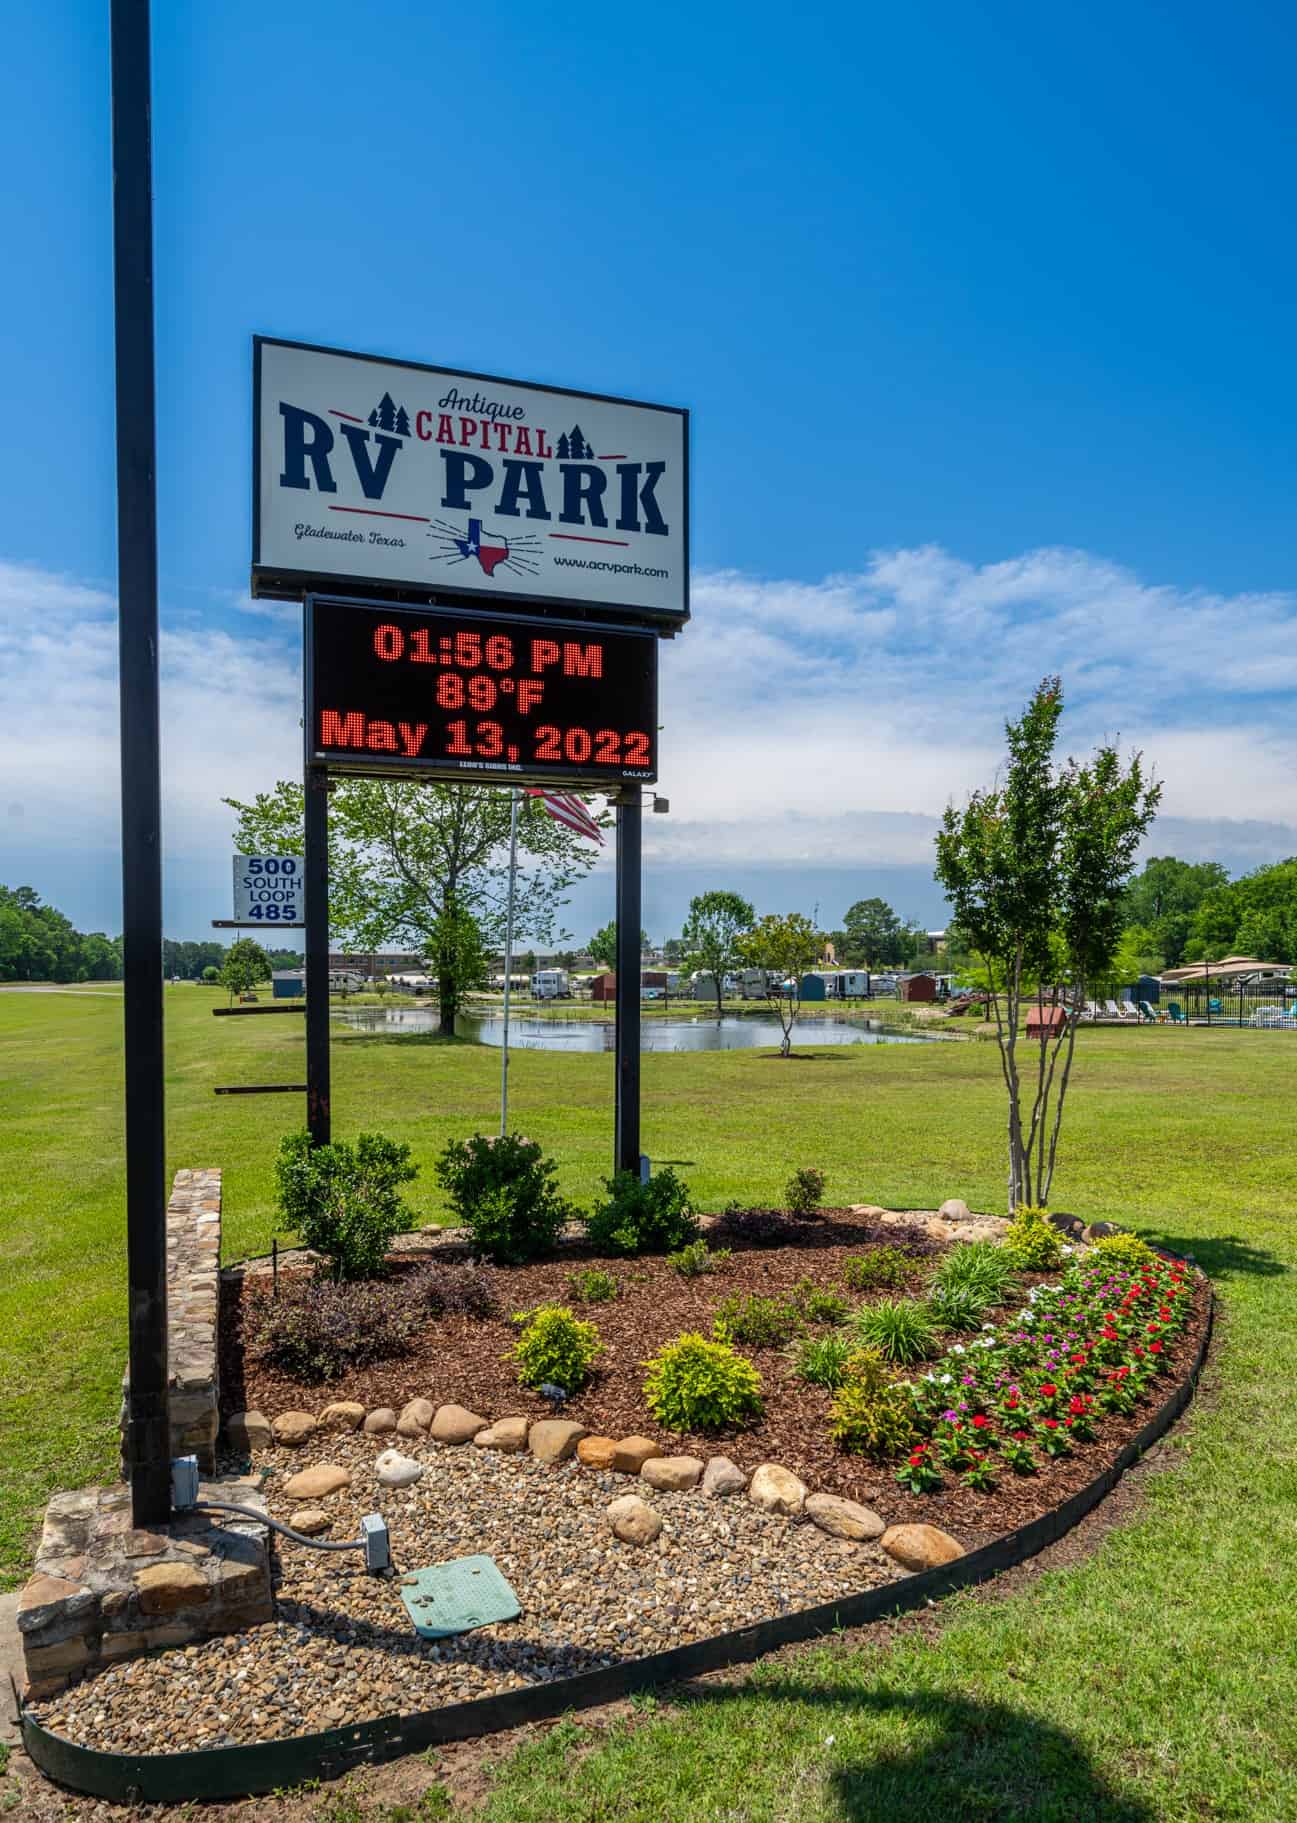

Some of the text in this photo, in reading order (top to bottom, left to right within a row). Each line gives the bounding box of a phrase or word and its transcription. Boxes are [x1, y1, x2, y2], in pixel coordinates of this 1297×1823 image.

[438, 387, 525, 422] Antique
[415, 410, 552, 459] CAPITAL
[279, 400, 669, 537] RV PARK
[294, 523, 406, 547] Gladewater Texas
[553, 556, 669, 579] www.acrvpark.com
[373, 624, 603, 678] 01:56 PM
[436, 672, 545, 715] 89°F
[320, 709, 650, 766] May 13, 2022
[248, 858, 296, 875] 500
[243, 877, 301, 889] SOUTH
[250, 890, 295, 902] LOOP
[248, 904, 296, 920] 485
